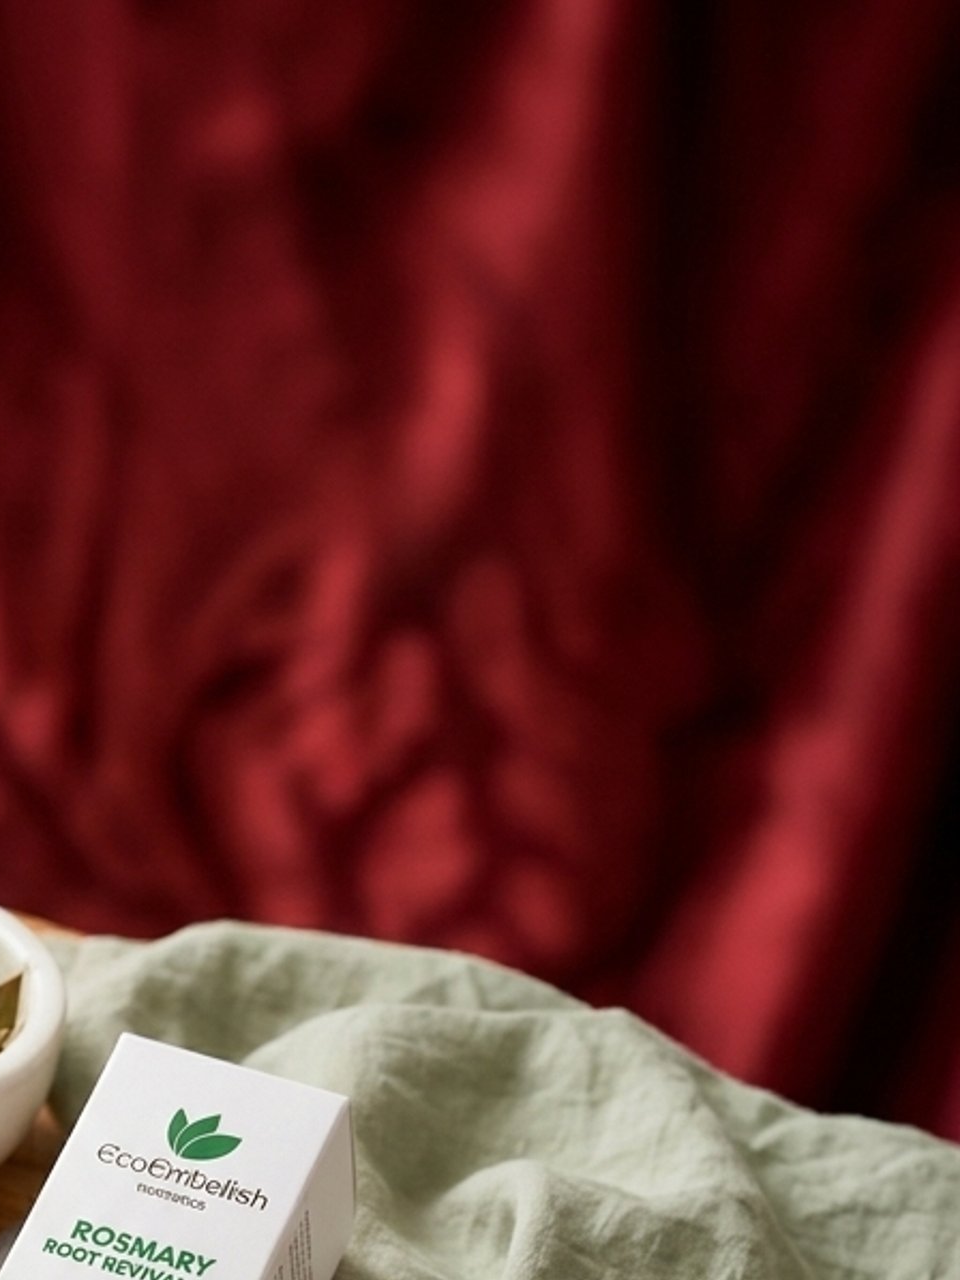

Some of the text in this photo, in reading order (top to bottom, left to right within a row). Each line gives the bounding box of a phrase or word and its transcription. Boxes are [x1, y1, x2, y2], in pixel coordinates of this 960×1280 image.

[97, 1143, 269, 1211] EcoEmbelish
[42, 1237, 102, 1266] ROOT
[70, 1219, 217, 1277] ROSMARY
